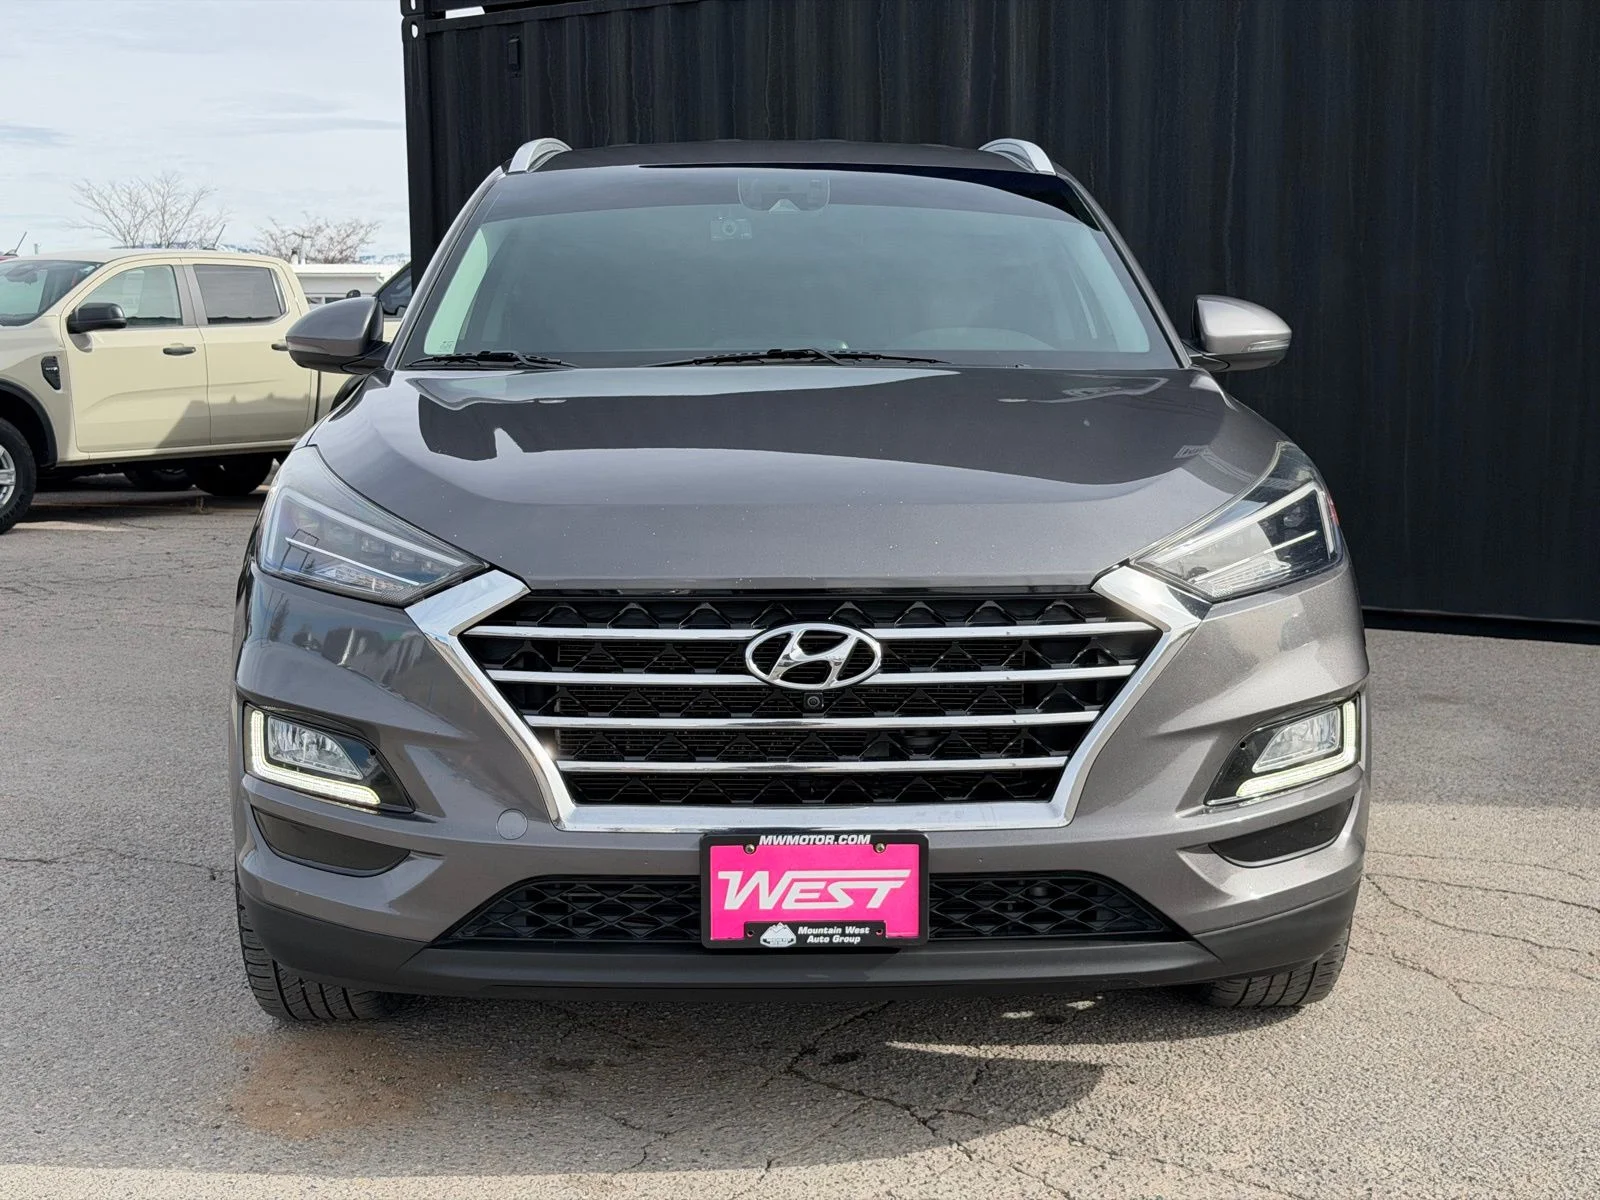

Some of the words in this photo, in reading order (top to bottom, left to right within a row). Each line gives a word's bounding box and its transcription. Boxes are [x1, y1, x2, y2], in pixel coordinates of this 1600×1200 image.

[759, 834, 871, 846] MWMOTOR.COM
[718, 869, 911, 910] WEST
[797, 926, 842, 935] Mountain
[844, 925, 871, 935] West
[806, 935, 830, 943] Auto
[832, 935, 862, 945] Group
